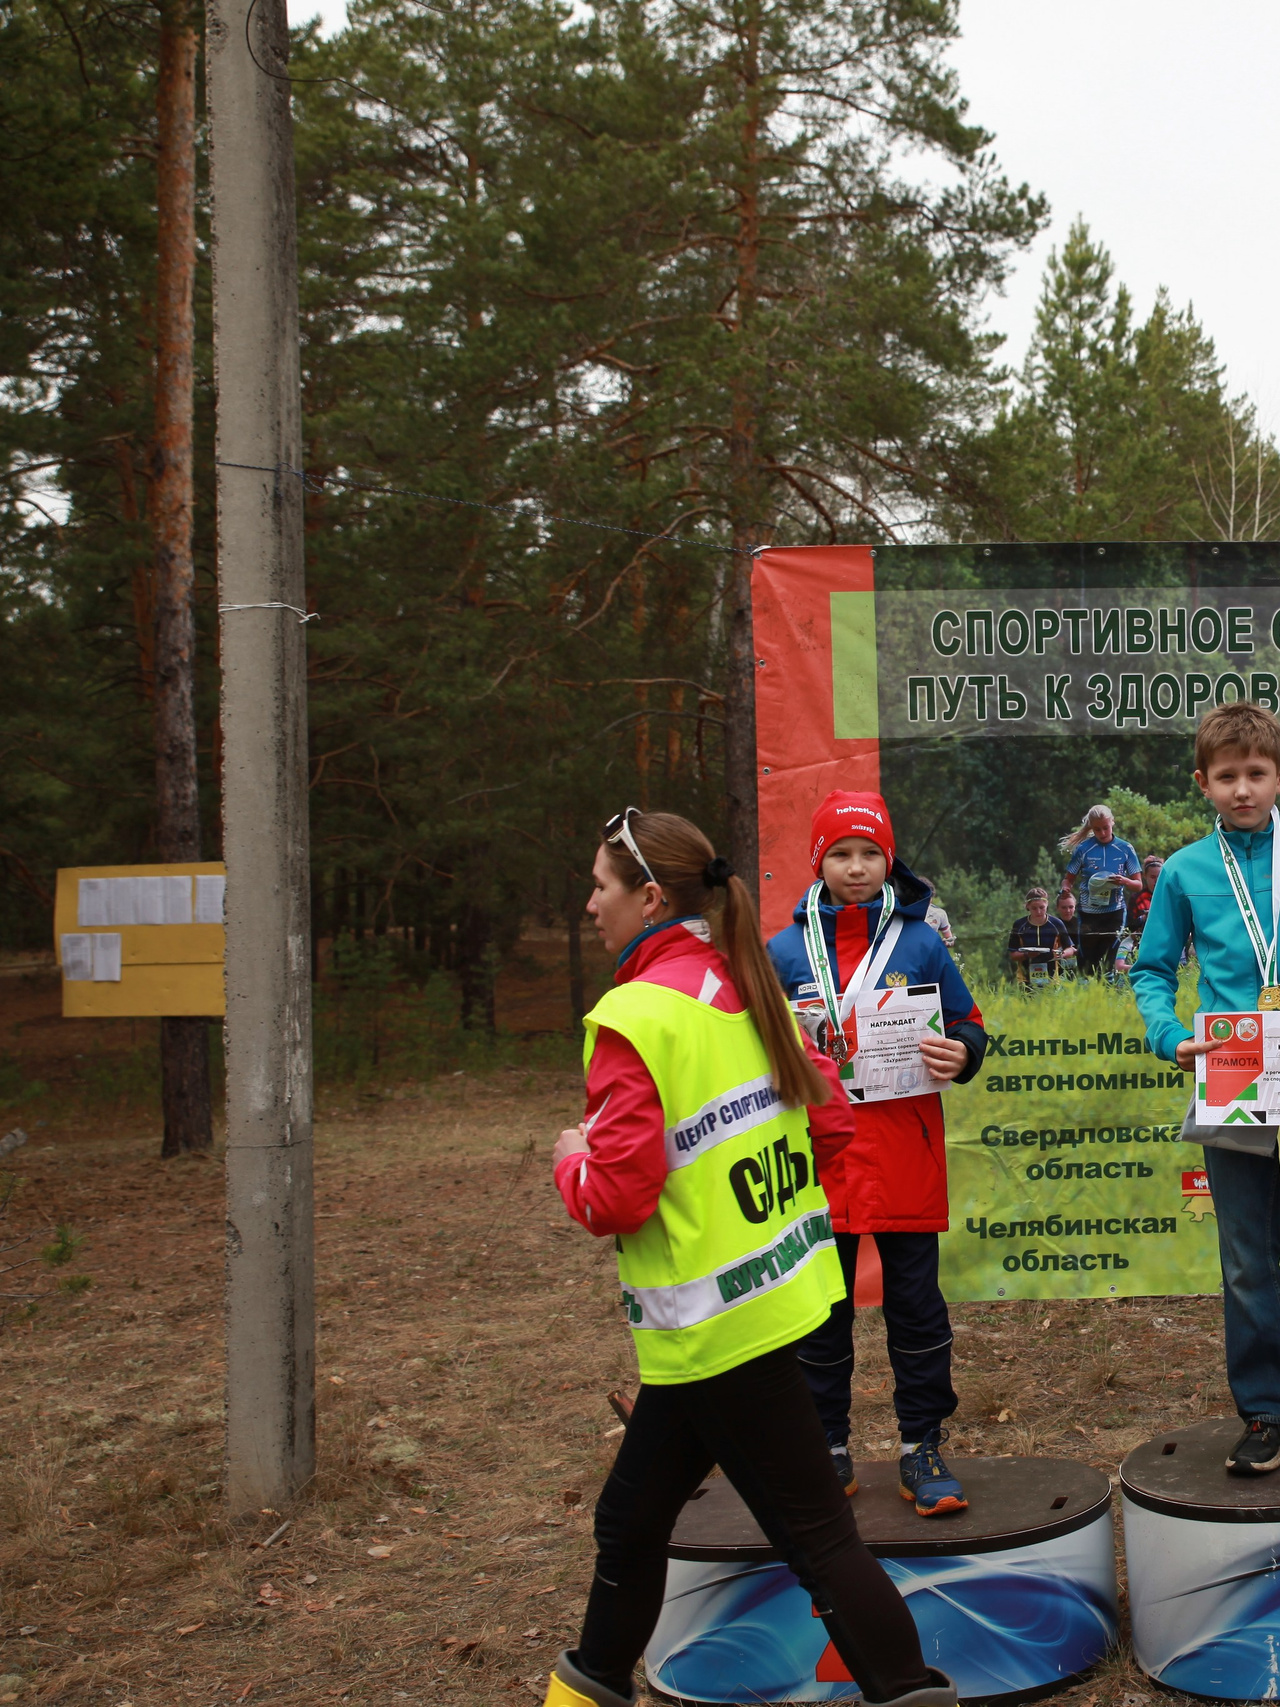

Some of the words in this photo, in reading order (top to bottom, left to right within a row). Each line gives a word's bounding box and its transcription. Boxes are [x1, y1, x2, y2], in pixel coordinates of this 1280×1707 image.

[931, 606, 1255, 657] СПОРТИВНОЕ
[907, 674, 1028, 722] ПУТЬ
[1045, 673, 1074, 721] К
[836, 805, 875, 816] helvetia
[870, 1017, 916, 1028] НАГРАЖДАЕТ
[985, 1032, 1153, 1058] Ханты-Ма
[1211, 1057, 1259, 1067] ГРАМОТА
[985, 1065, 1185, 1093] автономный
[980, 1123, 1183, 1151] Свердловска
[1025, 1157, 1154, 1181] область
[965, 1214, 1177, 1240] Челябинская
[1002, 1249, 1130, 1273] область
